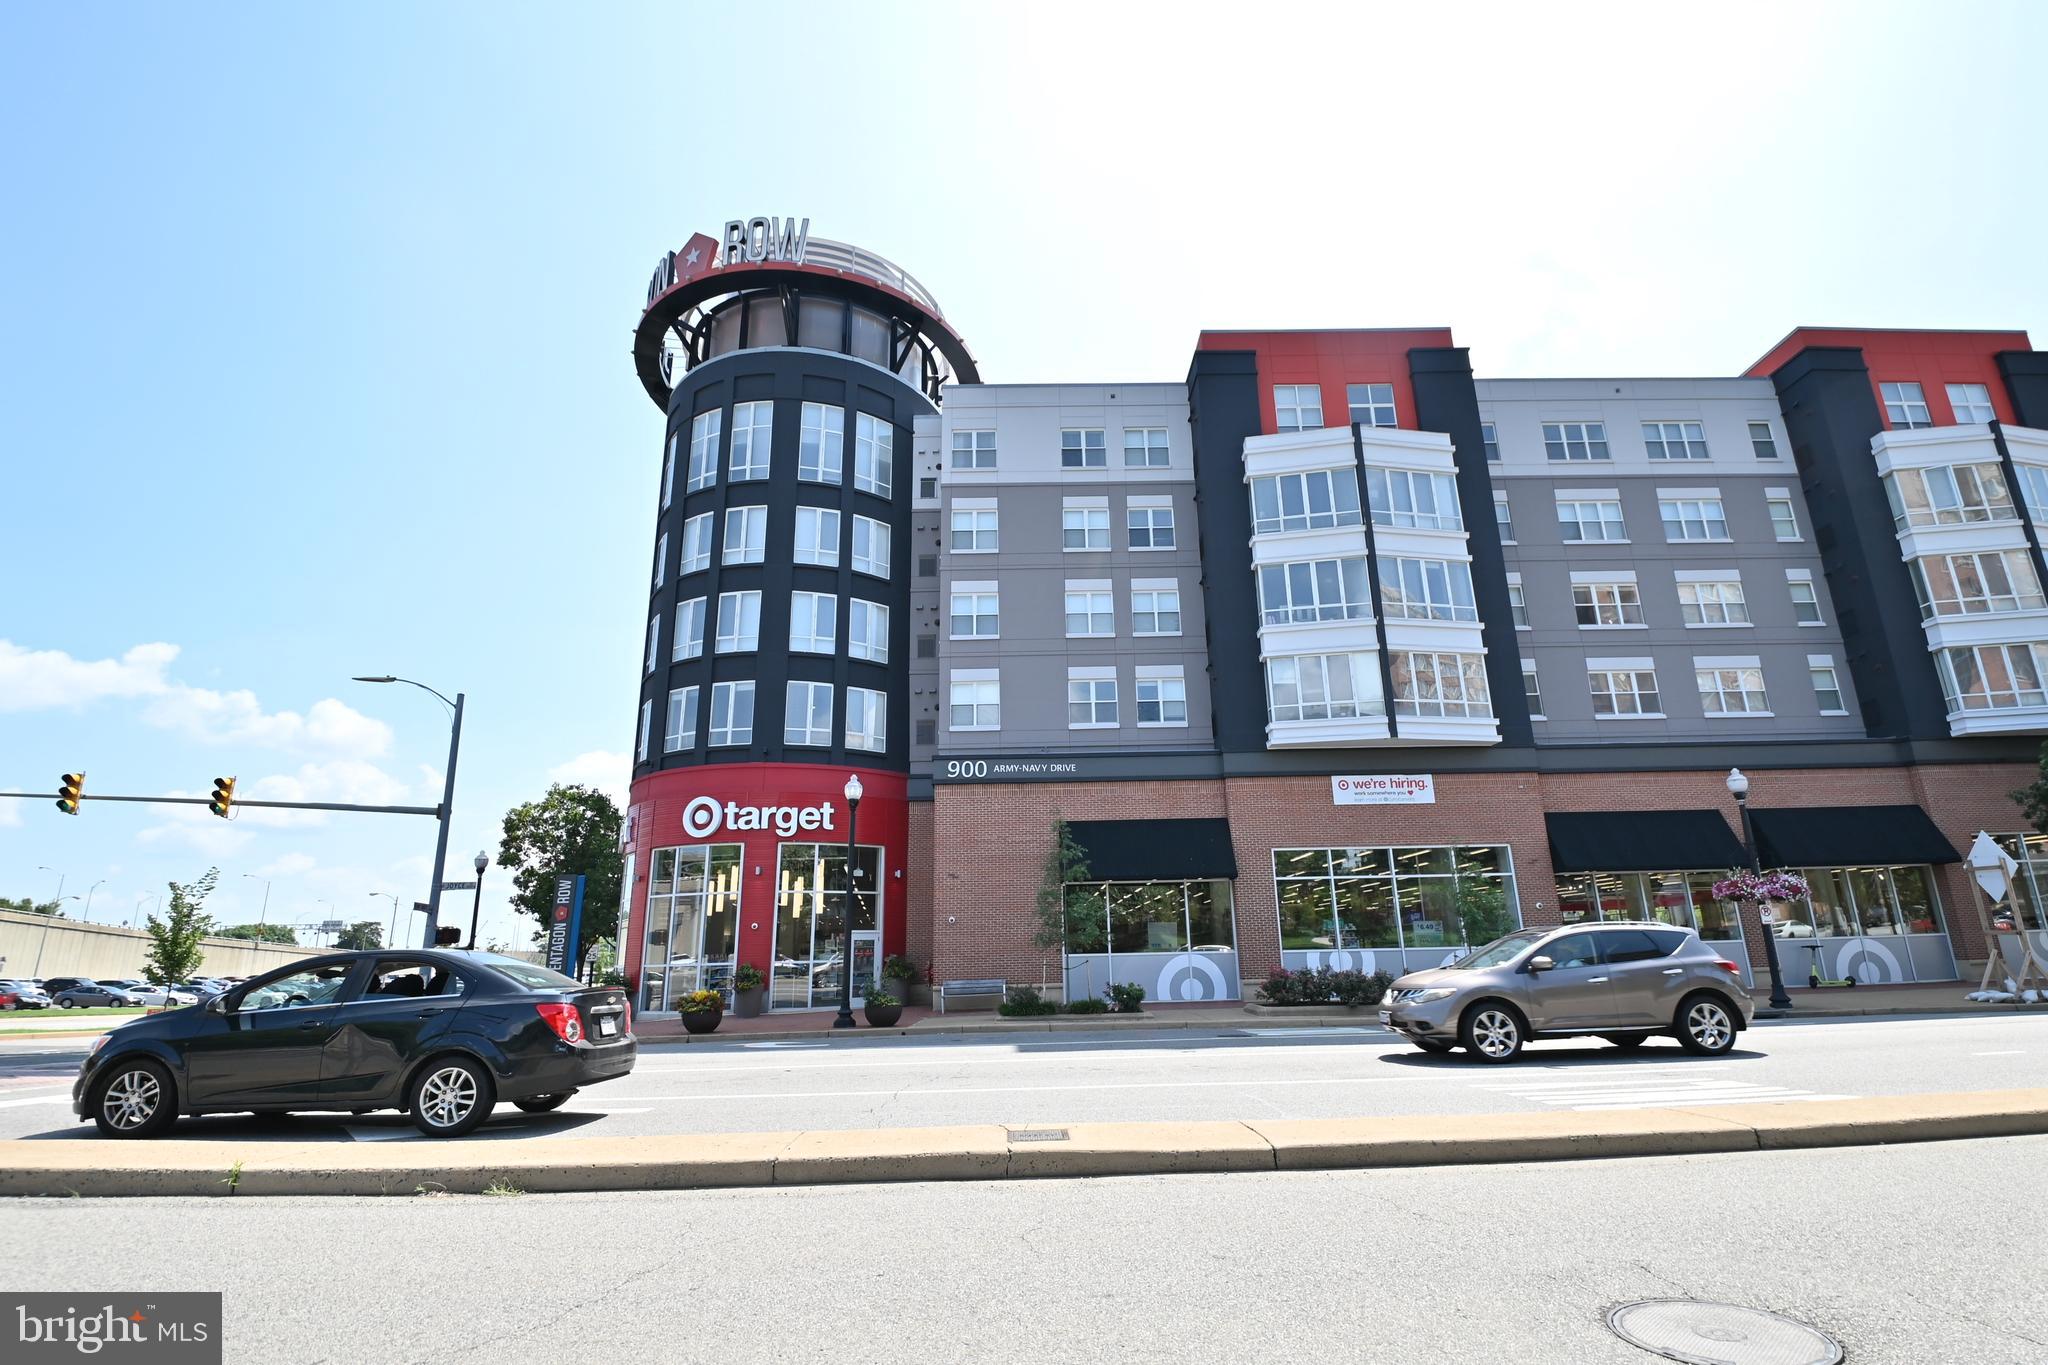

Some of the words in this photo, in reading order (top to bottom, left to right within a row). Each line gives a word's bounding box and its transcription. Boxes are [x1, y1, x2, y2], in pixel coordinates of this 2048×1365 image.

[722, 216, 810, 266] ROW
[947, 760, 987, 778] 900
[993, 763, 1048, 773] ARMY-NAVY
[1050, 763, 1076, 772] DRIVE
[1353, 778, 1386, 789] we're
[1389, 777, 1428, 791] hiring.
[723, 801, 834, 837] target
[557, 879, 572, 904] ROW
[549, 923, 567, 971] ENTAGON
[586, 952, 597, 960] 25
